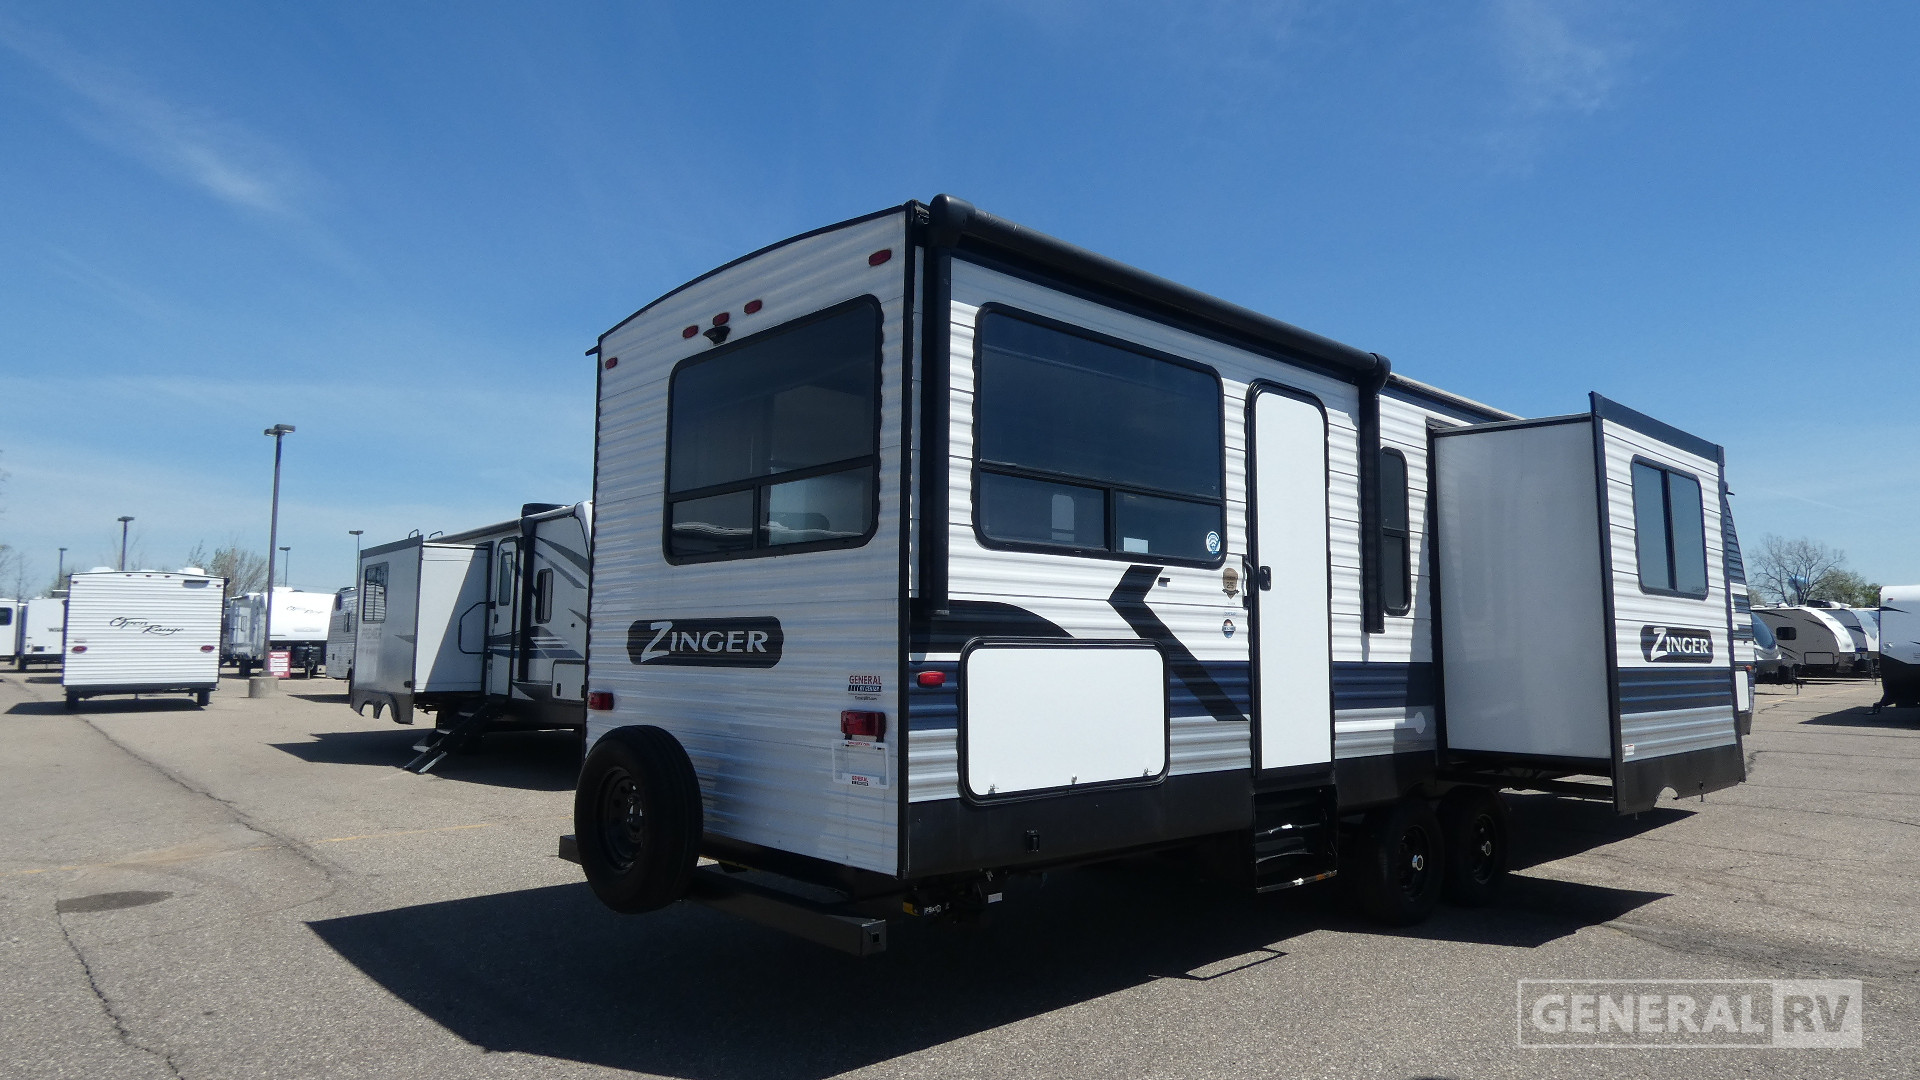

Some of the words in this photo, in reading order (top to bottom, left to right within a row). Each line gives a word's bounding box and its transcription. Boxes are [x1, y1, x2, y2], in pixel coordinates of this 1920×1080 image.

[110, 616, 149, 629] Open
[141, 624, 184, 636] Range
[640, 620, 769, 663] ZINGER
[1650, 627, 1710, 662] ZINGER
[848, 675, 882, 685] GENERAL
